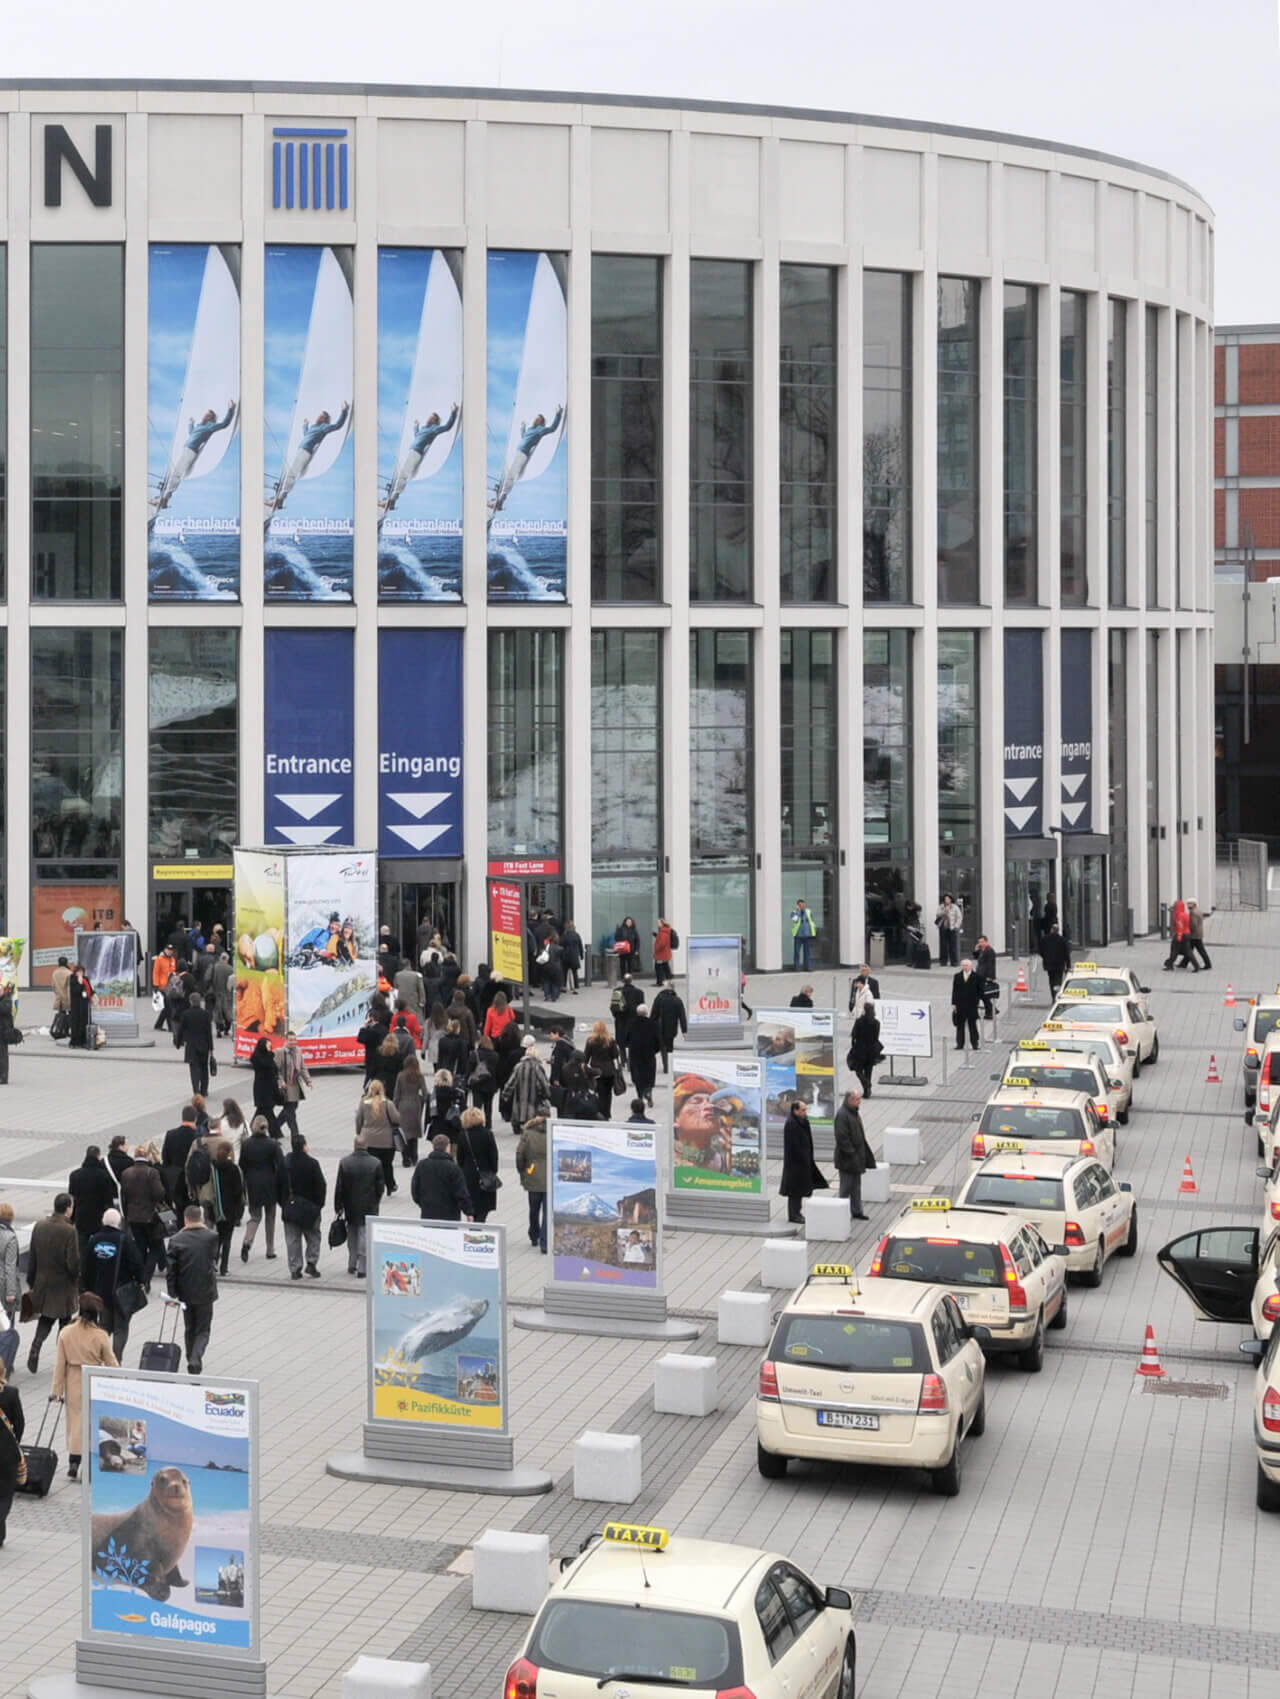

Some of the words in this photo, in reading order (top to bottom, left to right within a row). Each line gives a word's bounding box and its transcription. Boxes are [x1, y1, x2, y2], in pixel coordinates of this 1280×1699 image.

[1004, 743, 1043, 760] ntrance
[1060, 739, 1091, 761] ingang
[266, 754, 352, 775] Entrance
[380, 752, 461, 778] Eingang
[92, 909, 114, 920] ITB
[699, 996, 730, 1009] Cuba
[463, 1243, 495, 1254] Ecuador
[820, 1266, 845, 1274] TAXI
[205, 1403, 245, 1418] Ecuador
[412, 1400, 472, 1416] Pazifikküste
[827, 1413, 834, 1423] B
[841, 1415, 854, 1425] TN
[856, 1416, 874, 1427] 231
[613, 1527, 655, 1545] TAXI
[150, 1611, 217, 1635] Galápagos
